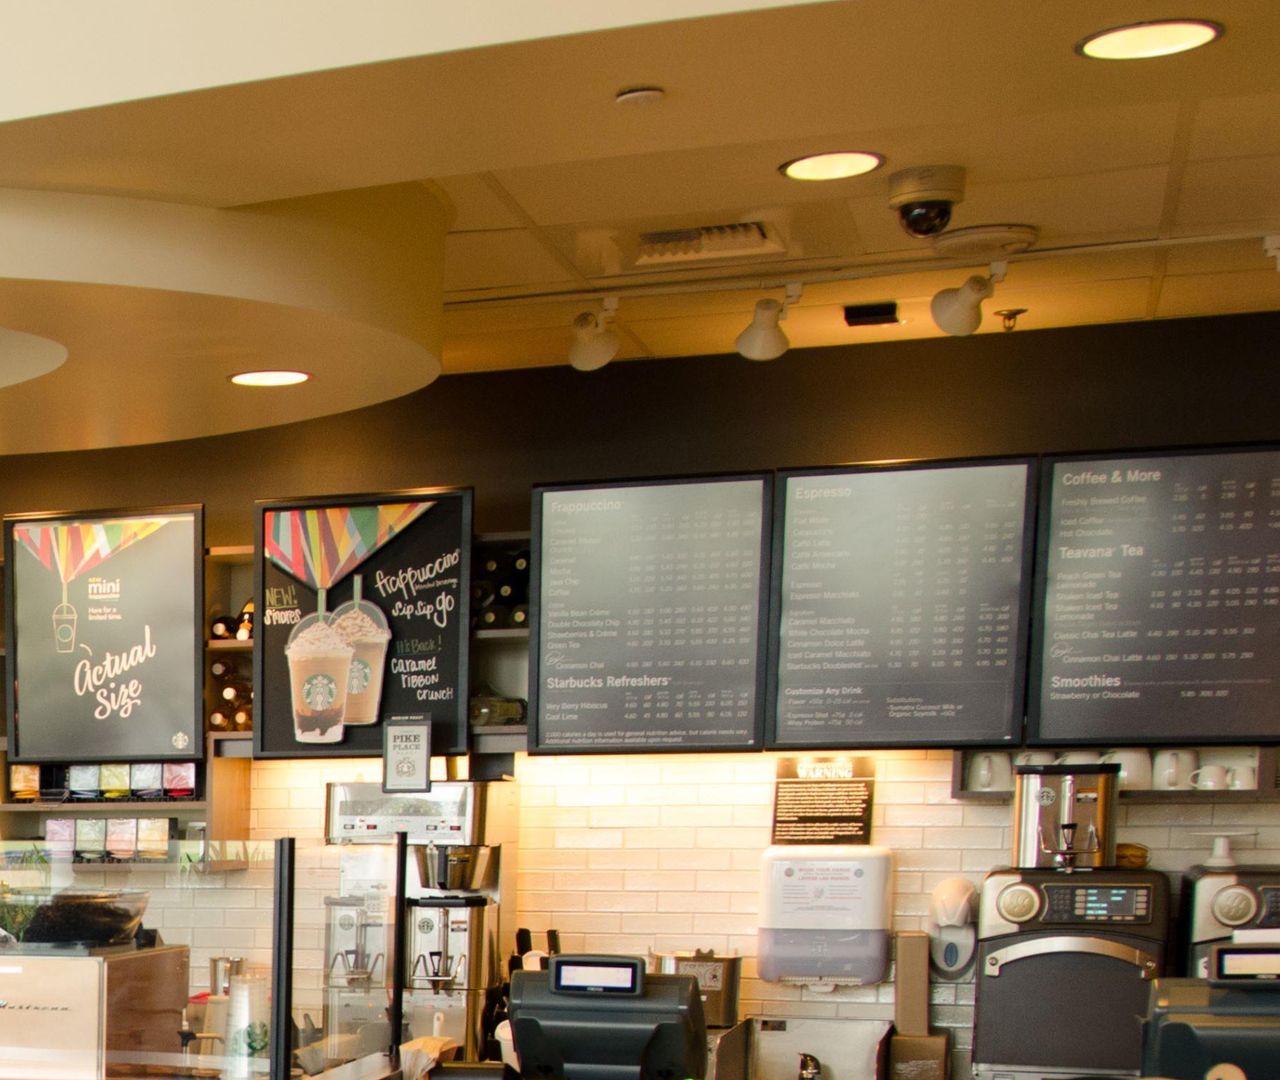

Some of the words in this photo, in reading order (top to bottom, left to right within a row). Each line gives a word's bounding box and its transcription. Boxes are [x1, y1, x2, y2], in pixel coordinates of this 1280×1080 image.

[1062, 472, 1107, 485] Coffee
[1111, 470, 1122, 483] &
[1127, 469, 1162, 482] More
[795, 487, 852, 501] Espresso
[551, 499, 621, 513] Frappuccino
[1059, 546, 1113, 559] Teavana
[1120, 544, 1144, 556] Tea
[88, 578, 121, 594] mini
[265, 584, 298, 606] NEW!
[433, 591, 455, 628] go
[73, 625, 157, 698] Actual
[546, 676, 603, 689] Starbucks
[606, 675, 669, 688] Refreshers
[1051, 674, 1121, 688] Smoothies
[93, 678, 143, 720] Size
[392, 734, 422, 743] PIKE
[392, 743, 422, 751] PLACE
